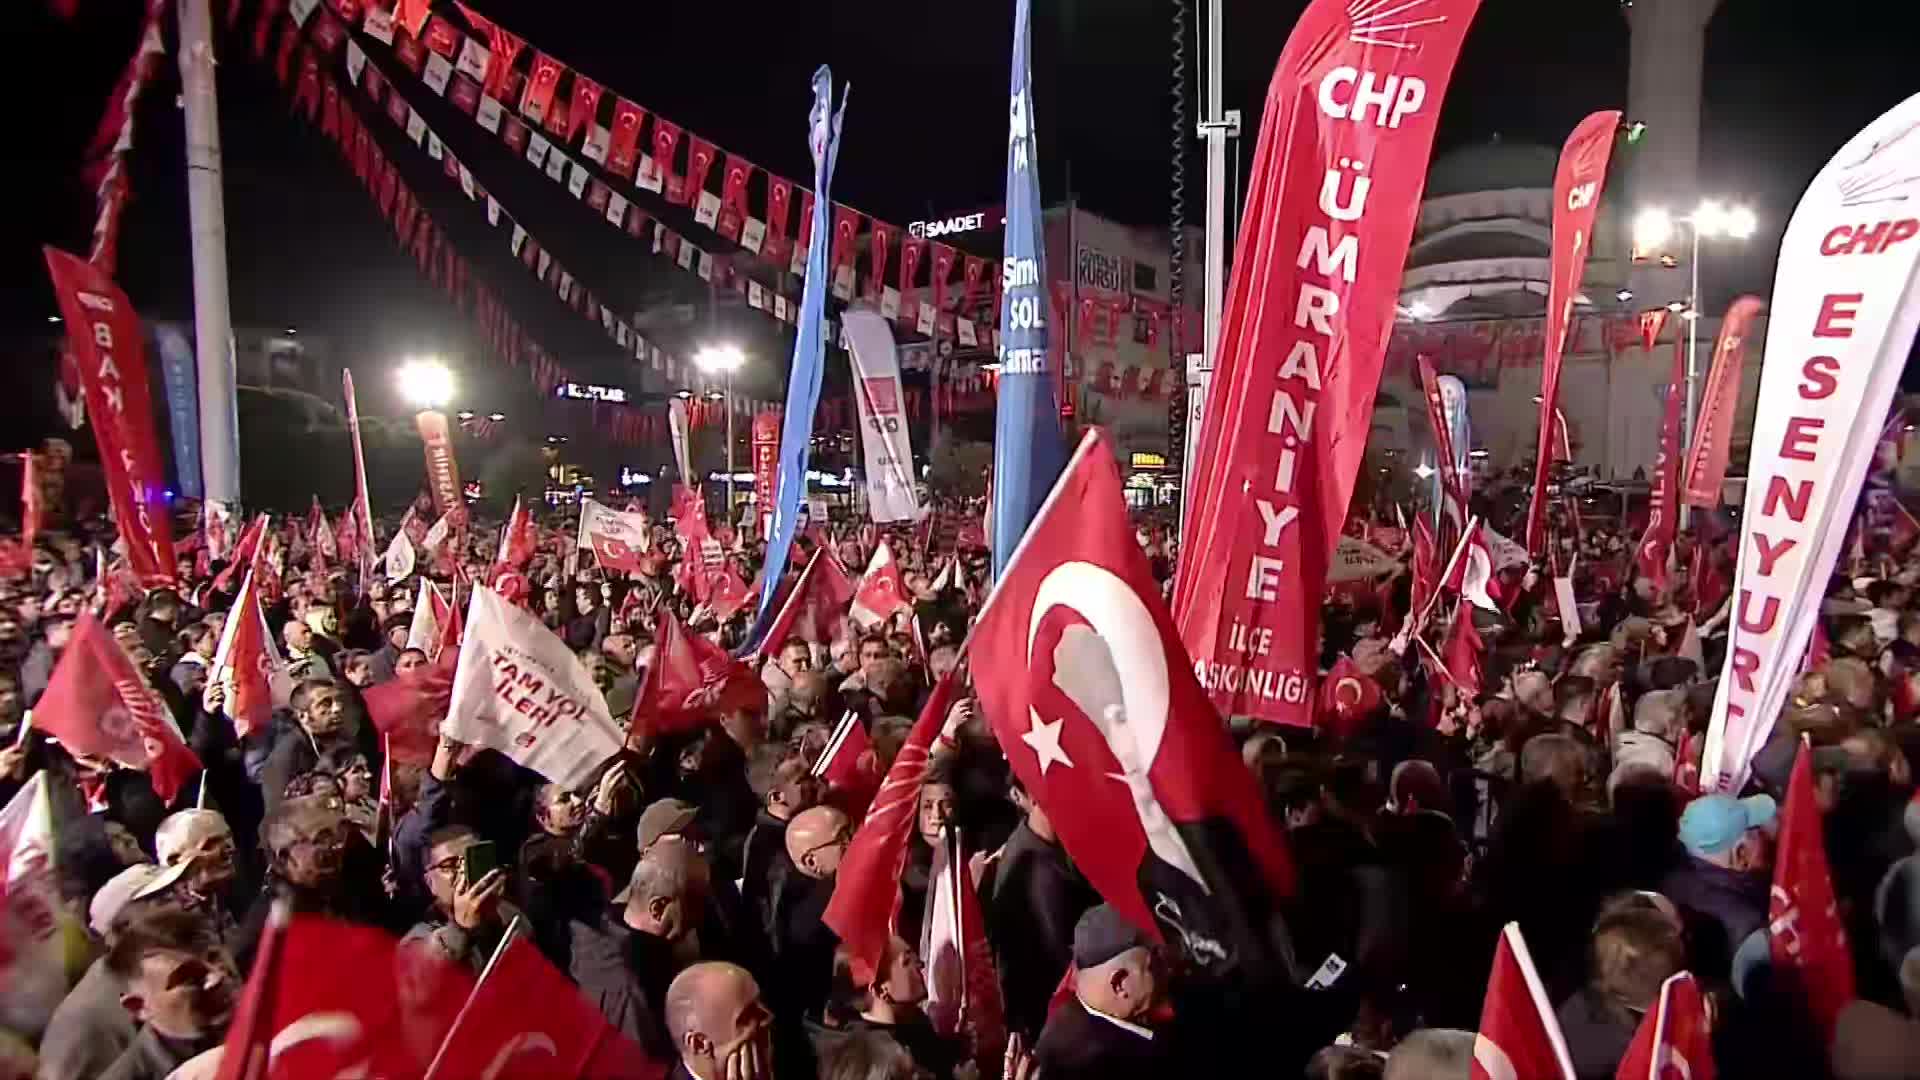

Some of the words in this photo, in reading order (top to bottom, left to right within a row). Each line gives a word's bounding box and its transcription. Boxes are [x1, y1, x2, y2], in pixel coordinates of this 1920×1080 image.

[1318, 66, 1426, 129] CHP
[926, 213, 985, 239] SAADET
[1819, 217, 1920, 257] CHP
[1009, 296, 1044, 331] SOL
[1245, 158, 1372, 602] ÜMRANİYE
[1228, 615, 1273, 661] İLÇE
[493, 653, 545, 695] TAM
[1193, 658, 1309, 703] AŞKANLIĞI
